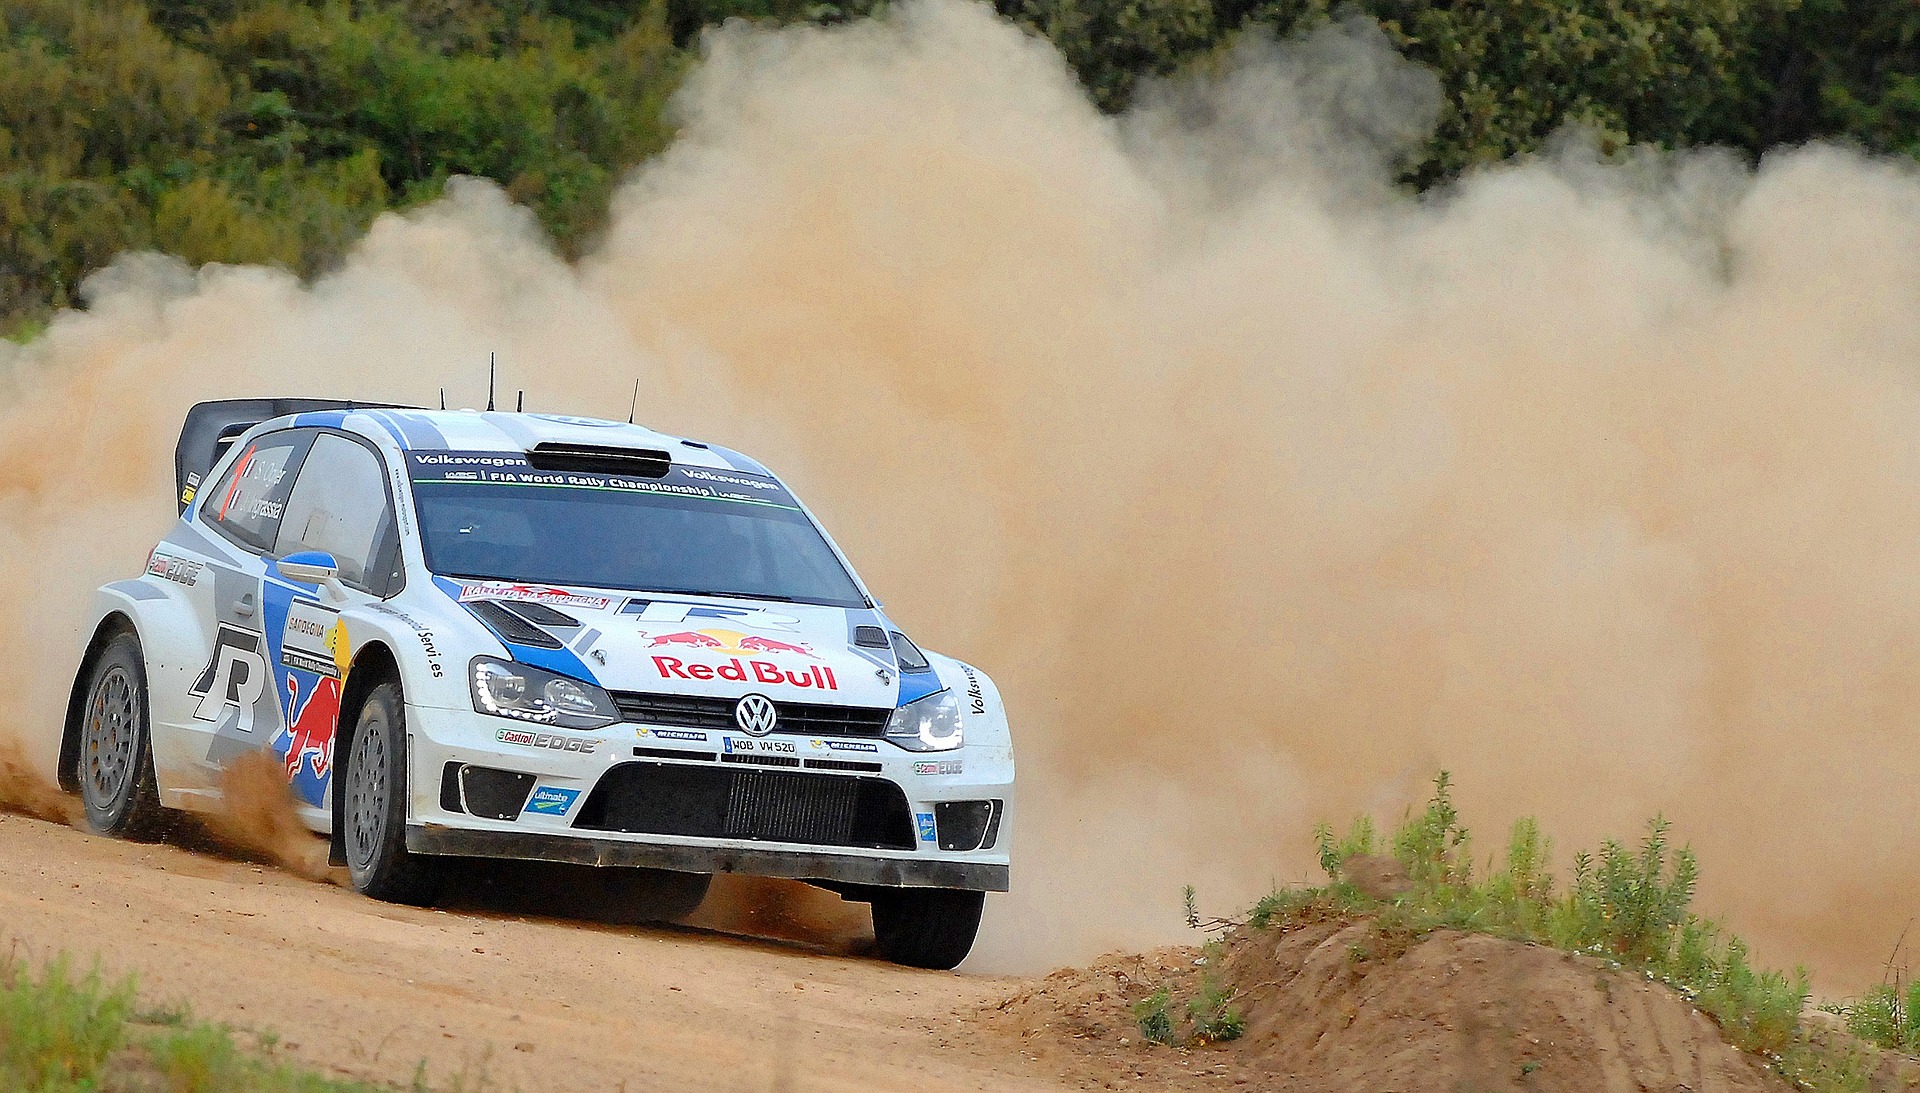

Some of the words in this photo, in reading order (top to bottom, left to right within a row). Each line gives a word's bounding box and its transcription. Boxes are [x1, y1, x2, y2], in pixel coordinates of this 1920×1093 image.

[415, 454, 527, 467] Volkswagen
[490, 472, 517, 482] FIA
[518, 473, 565, 484] World
[567, 476, 606, 488] Rally
[608, 478, 710, 498] Championship
[681, 469, 779, 490] Volkswagen
[466, 585, 501, 597] RALLY
[502, 589, 539, 600] ITALIA
[541, 592, 603, 606] SARDEGNA
[187, 621, 267, 733] R
[651, 655, 748, 682] Red
[749, 660, 838, 691] Bull
[503, 730, 533, 745] Castrol
[534, 733, 600, 754] EDGE
[656, 730, 706, 740] MICHELIN
[732, 740, 754, 751] WOB
[759, 741, 774, 752] VW
[774, 742, 796, 753] 520
[533, 790, 569, 803] ultimate
